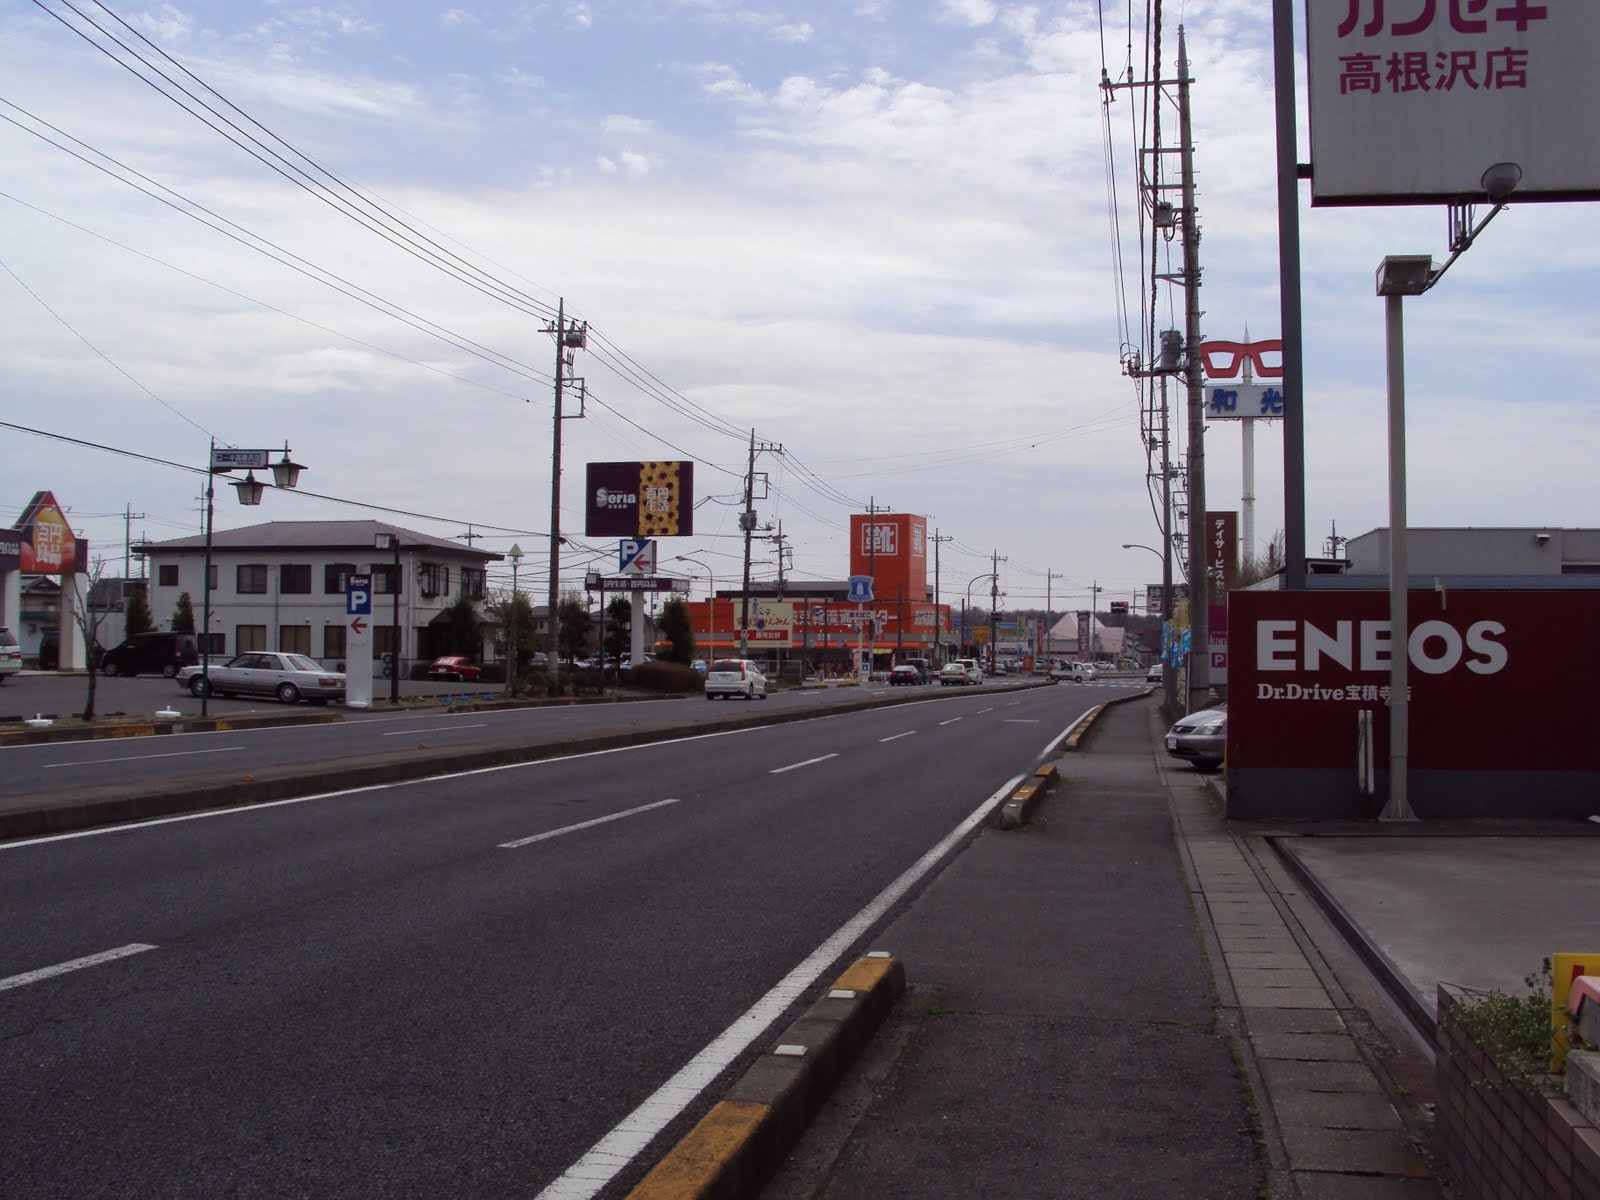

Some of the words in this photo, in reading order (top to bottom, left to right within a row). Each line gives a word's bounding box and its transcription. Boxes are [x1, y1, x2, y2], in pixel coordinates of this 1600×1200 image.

[1338, 47, 1528, 95] 高根沢店
[1210, 388, 1283, 415] 和光
[622, 541, 639, 560] P
[865, 526, 895, 552] 靴
[351, 591, 368, 611] P
[1257, 620, 1508, 675] ENEOS
[1214, 655, 1225, 667] P
[1257, 683, 1344, 700] Dr.Drive
[1346, 684, 1411, 701] 宝積寺
